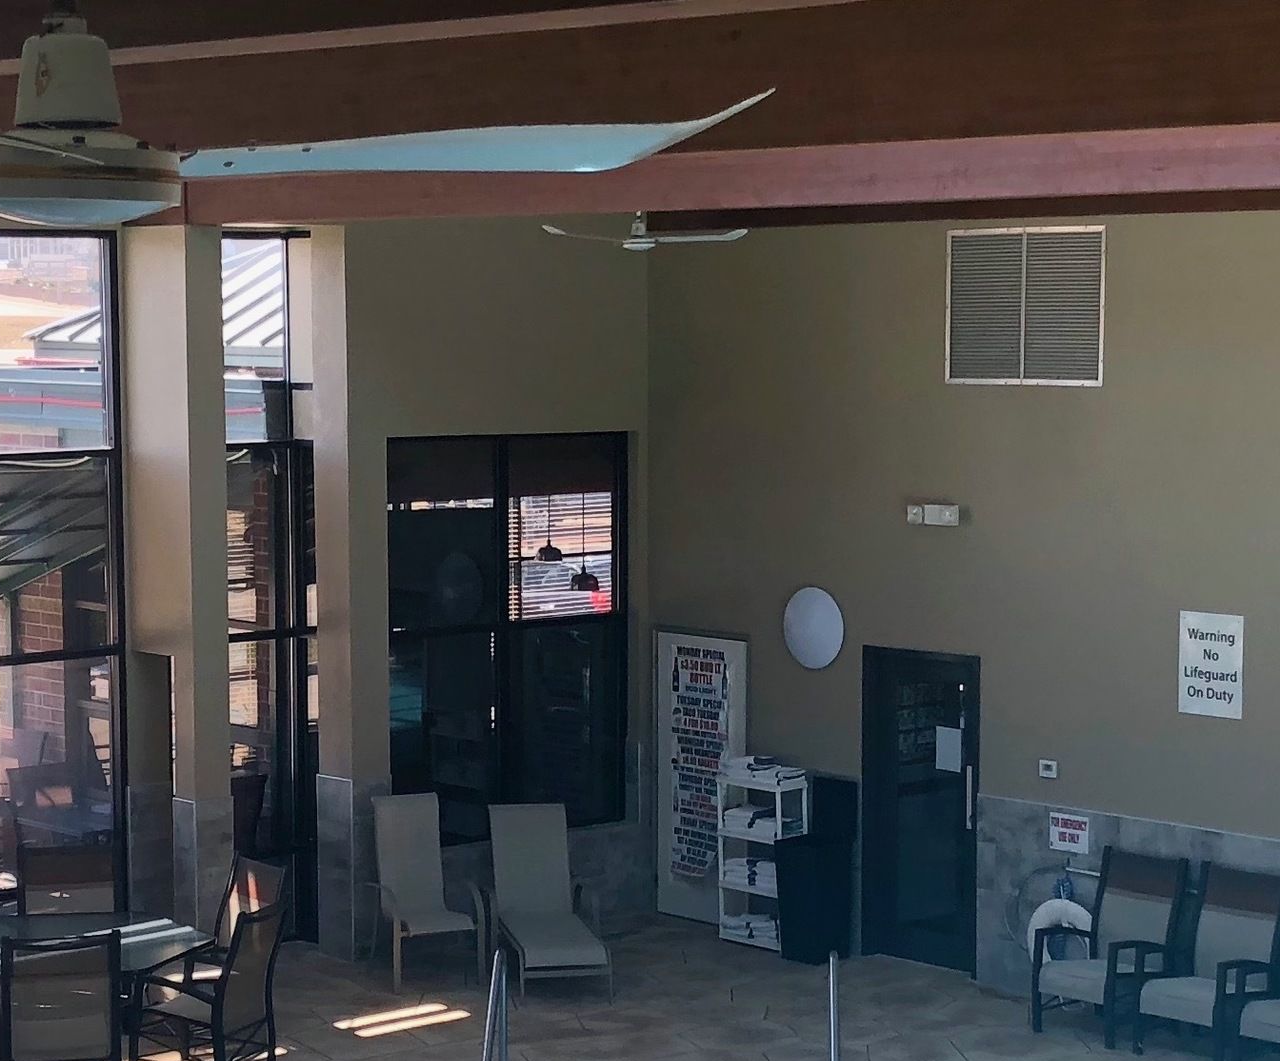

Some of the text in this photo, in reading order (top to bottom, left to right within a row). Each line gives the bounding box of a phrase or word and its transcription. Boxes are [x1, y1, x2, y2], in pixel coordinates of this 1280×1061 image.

[1187, 628, 1235, 647] Warning
[1203, 649, 1219, 661] No
[1184, 666, 1237, 683] Lifeguard
[1187, 685, 1234, 704] On Duty
